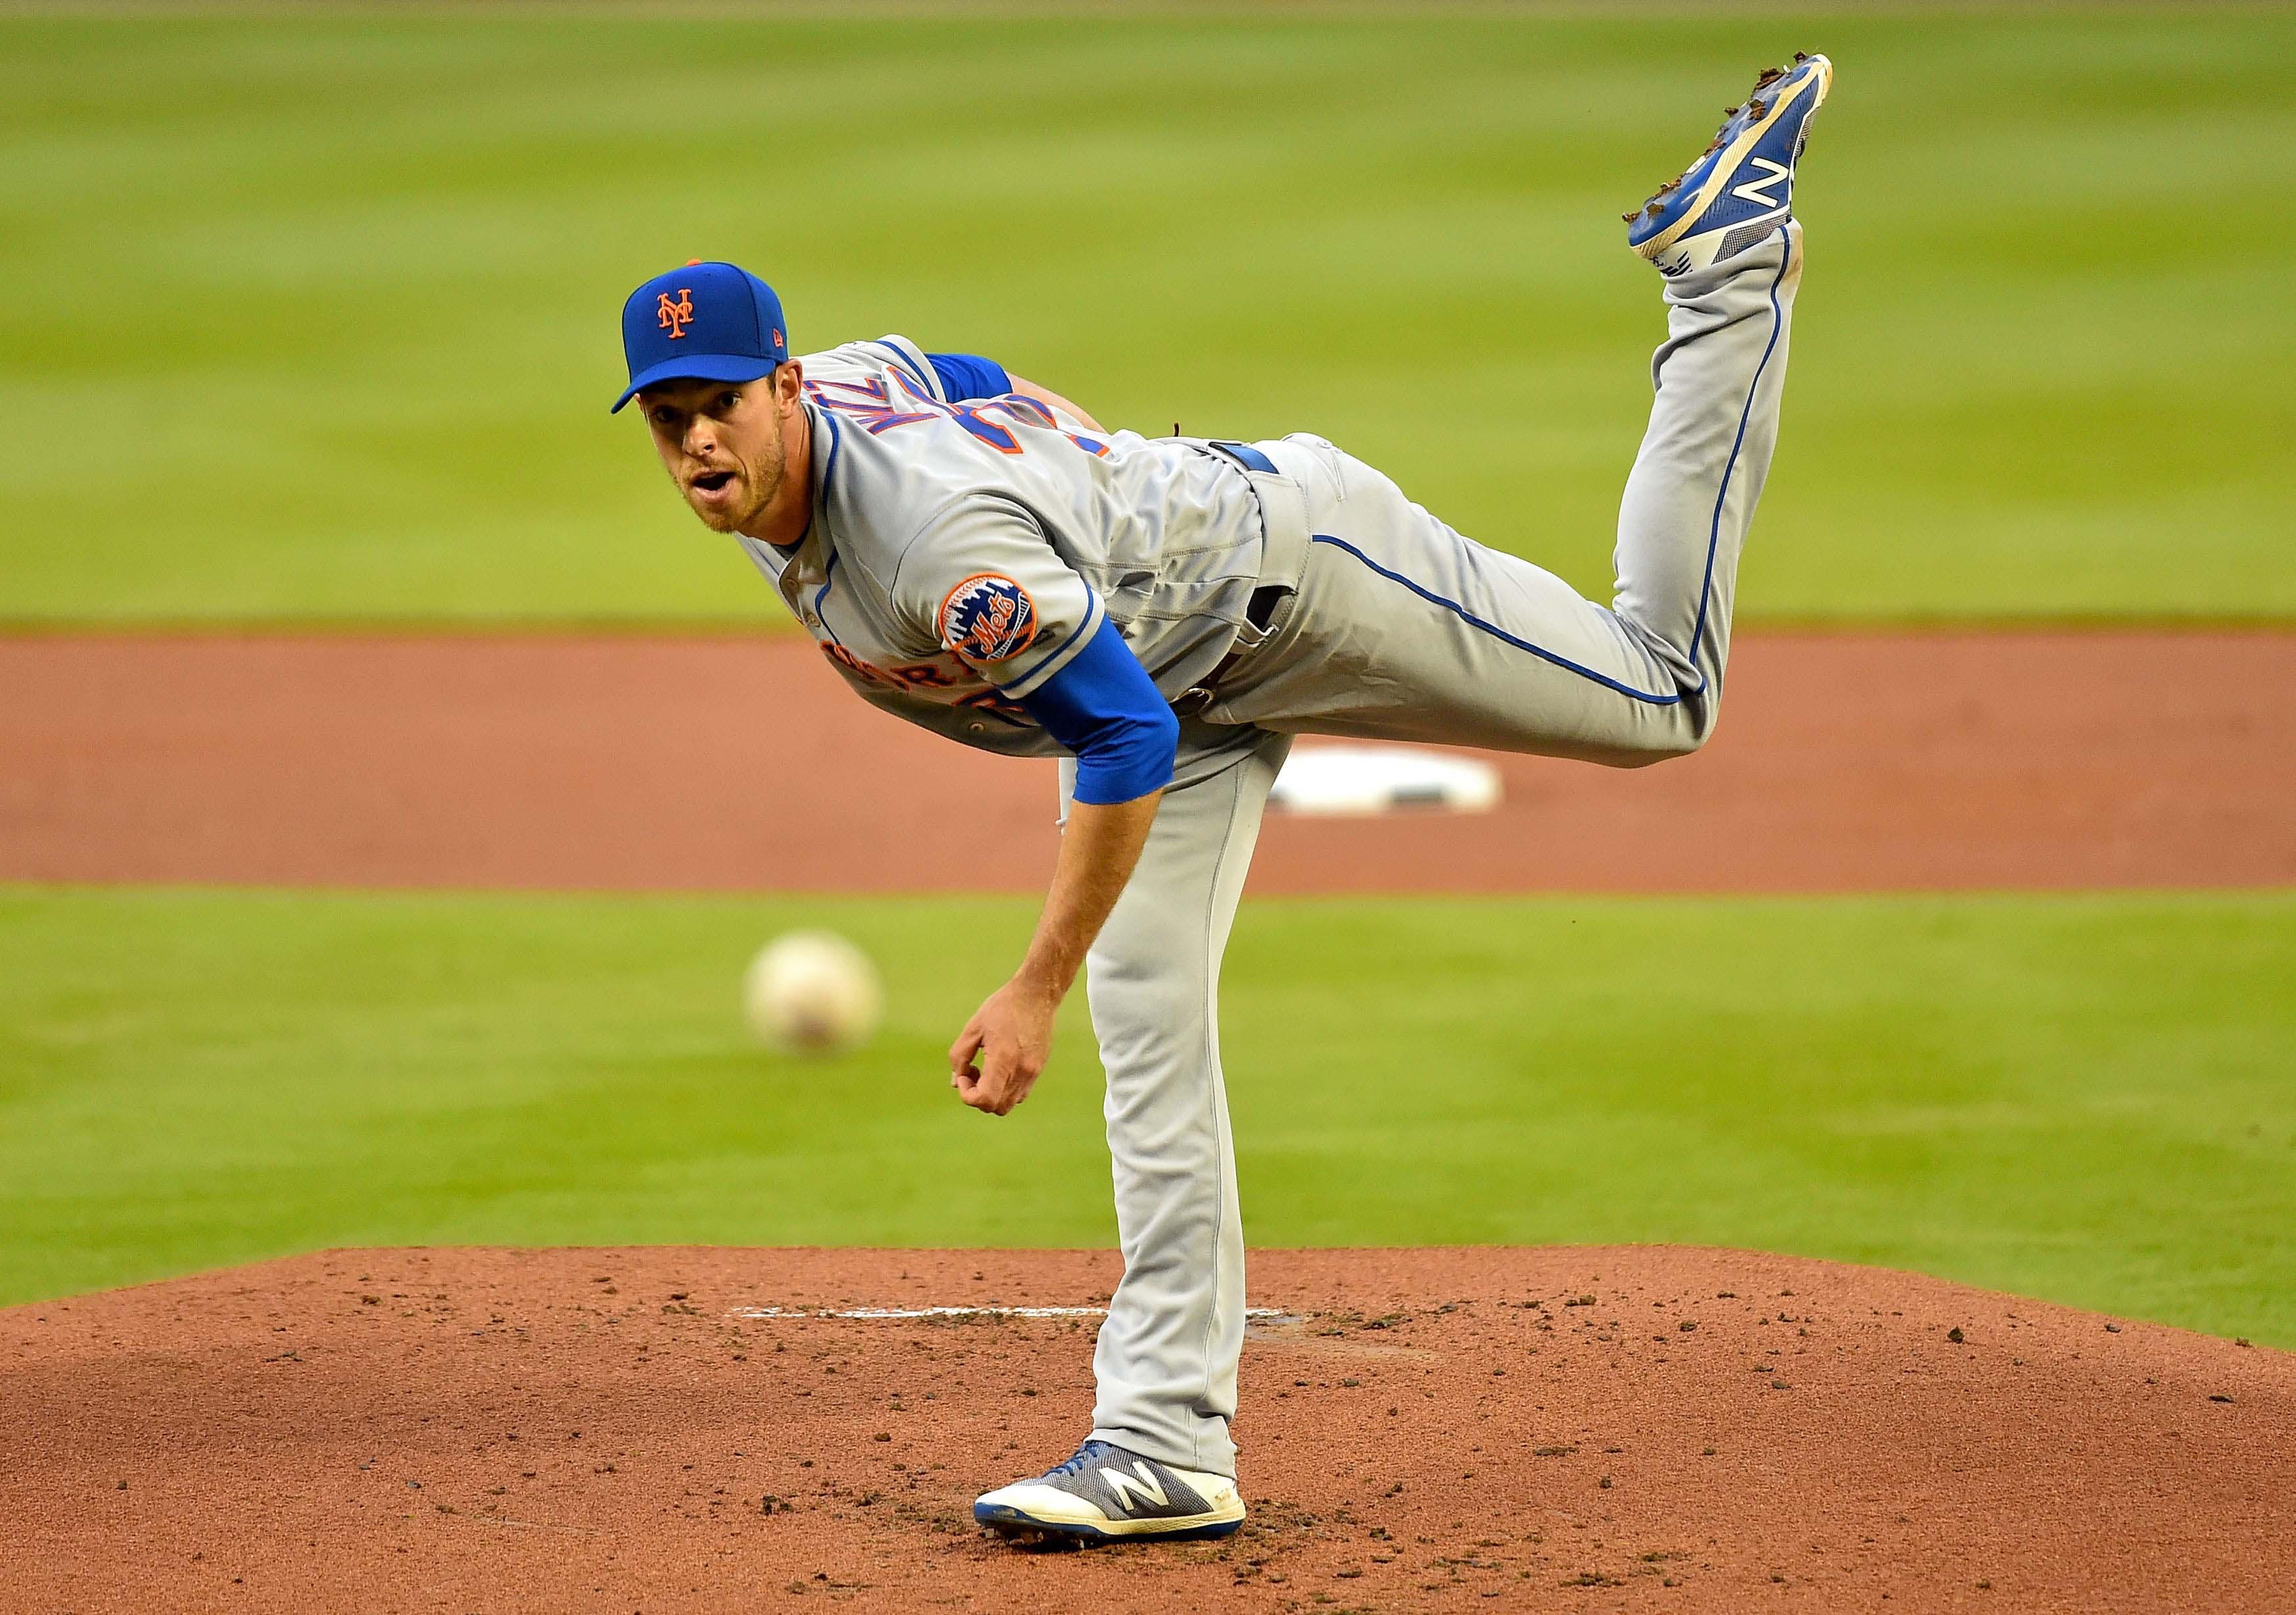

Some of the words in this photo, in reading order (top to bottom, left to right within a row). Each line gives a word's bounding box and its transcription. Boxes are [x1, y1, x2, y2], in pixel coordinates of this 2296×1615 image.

[657, 289, 694, 339] NY
[971, 591, 1016, 654] Mets
[1098, 1461, 1170, 1511] N
